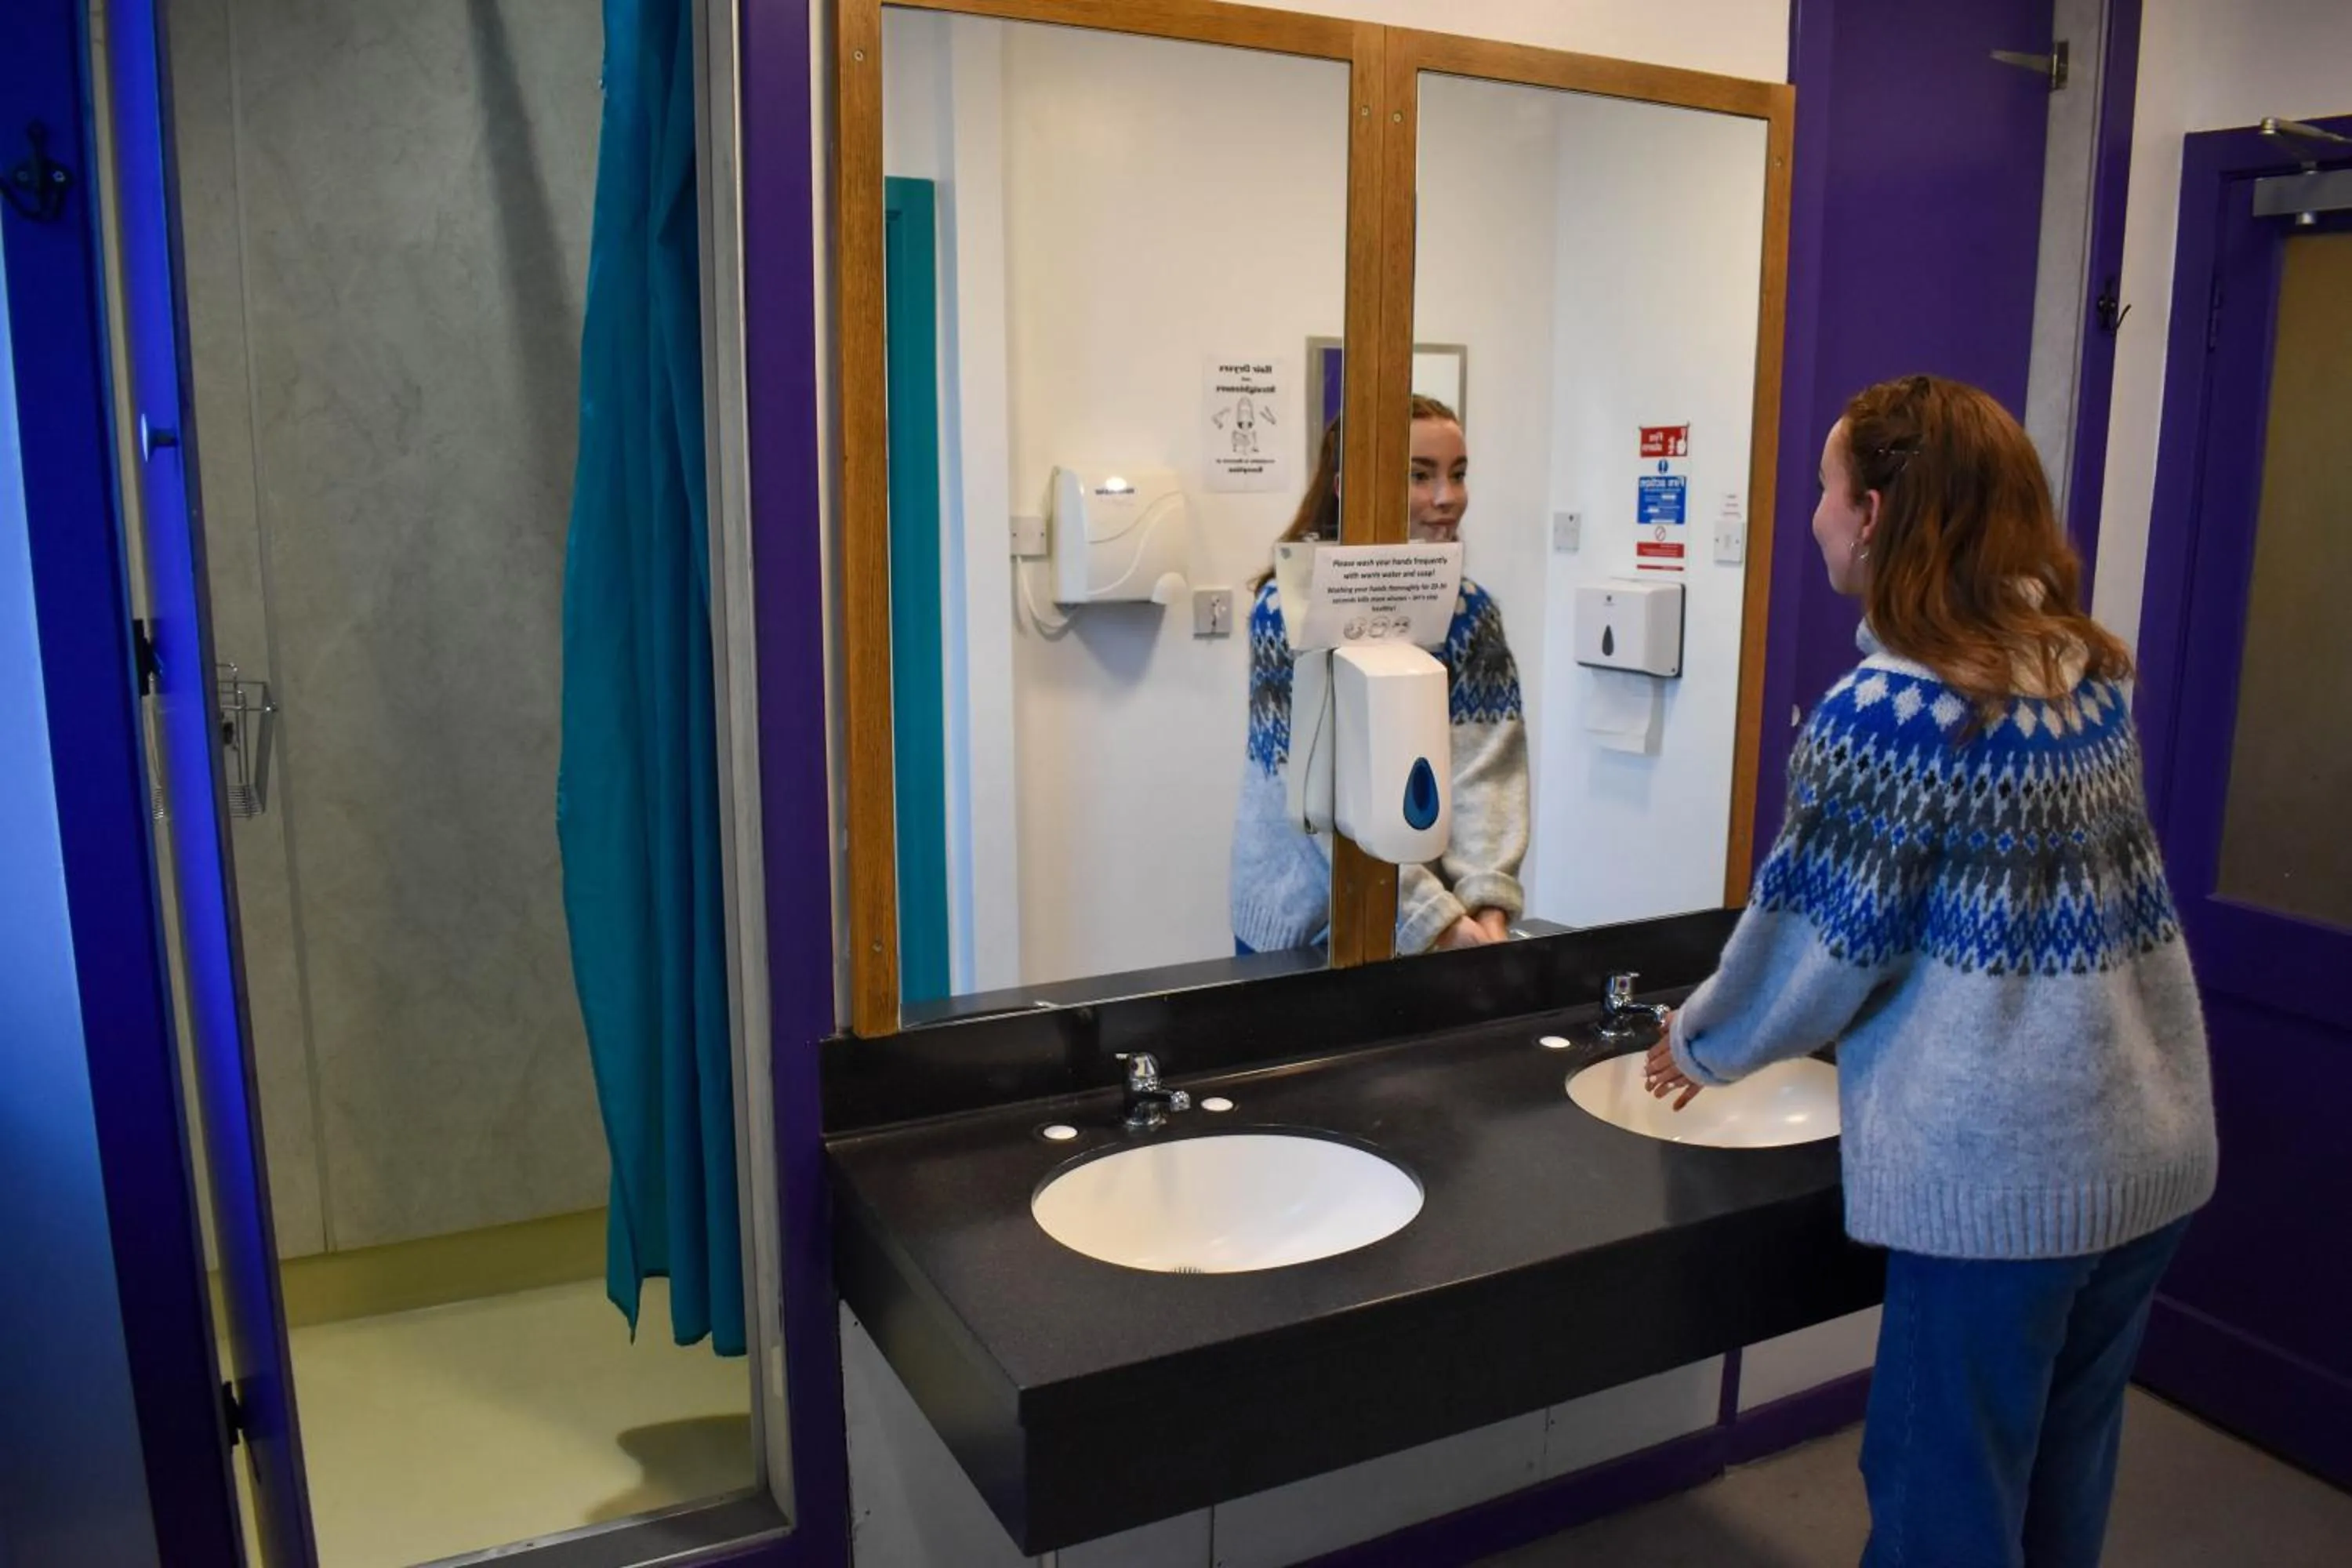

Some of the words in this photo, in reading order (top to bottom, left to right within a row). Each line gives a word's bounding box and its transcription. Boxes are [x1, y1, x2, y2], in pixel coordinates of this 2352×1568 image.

[1375, 559, 1391, 568] your
[1392, 557, 1412, 565] hands
[1414, 556, 1448, 565] frequently
[1403, 569, 1416, 578] and
[1417, 568, 1436, 578] soap!
